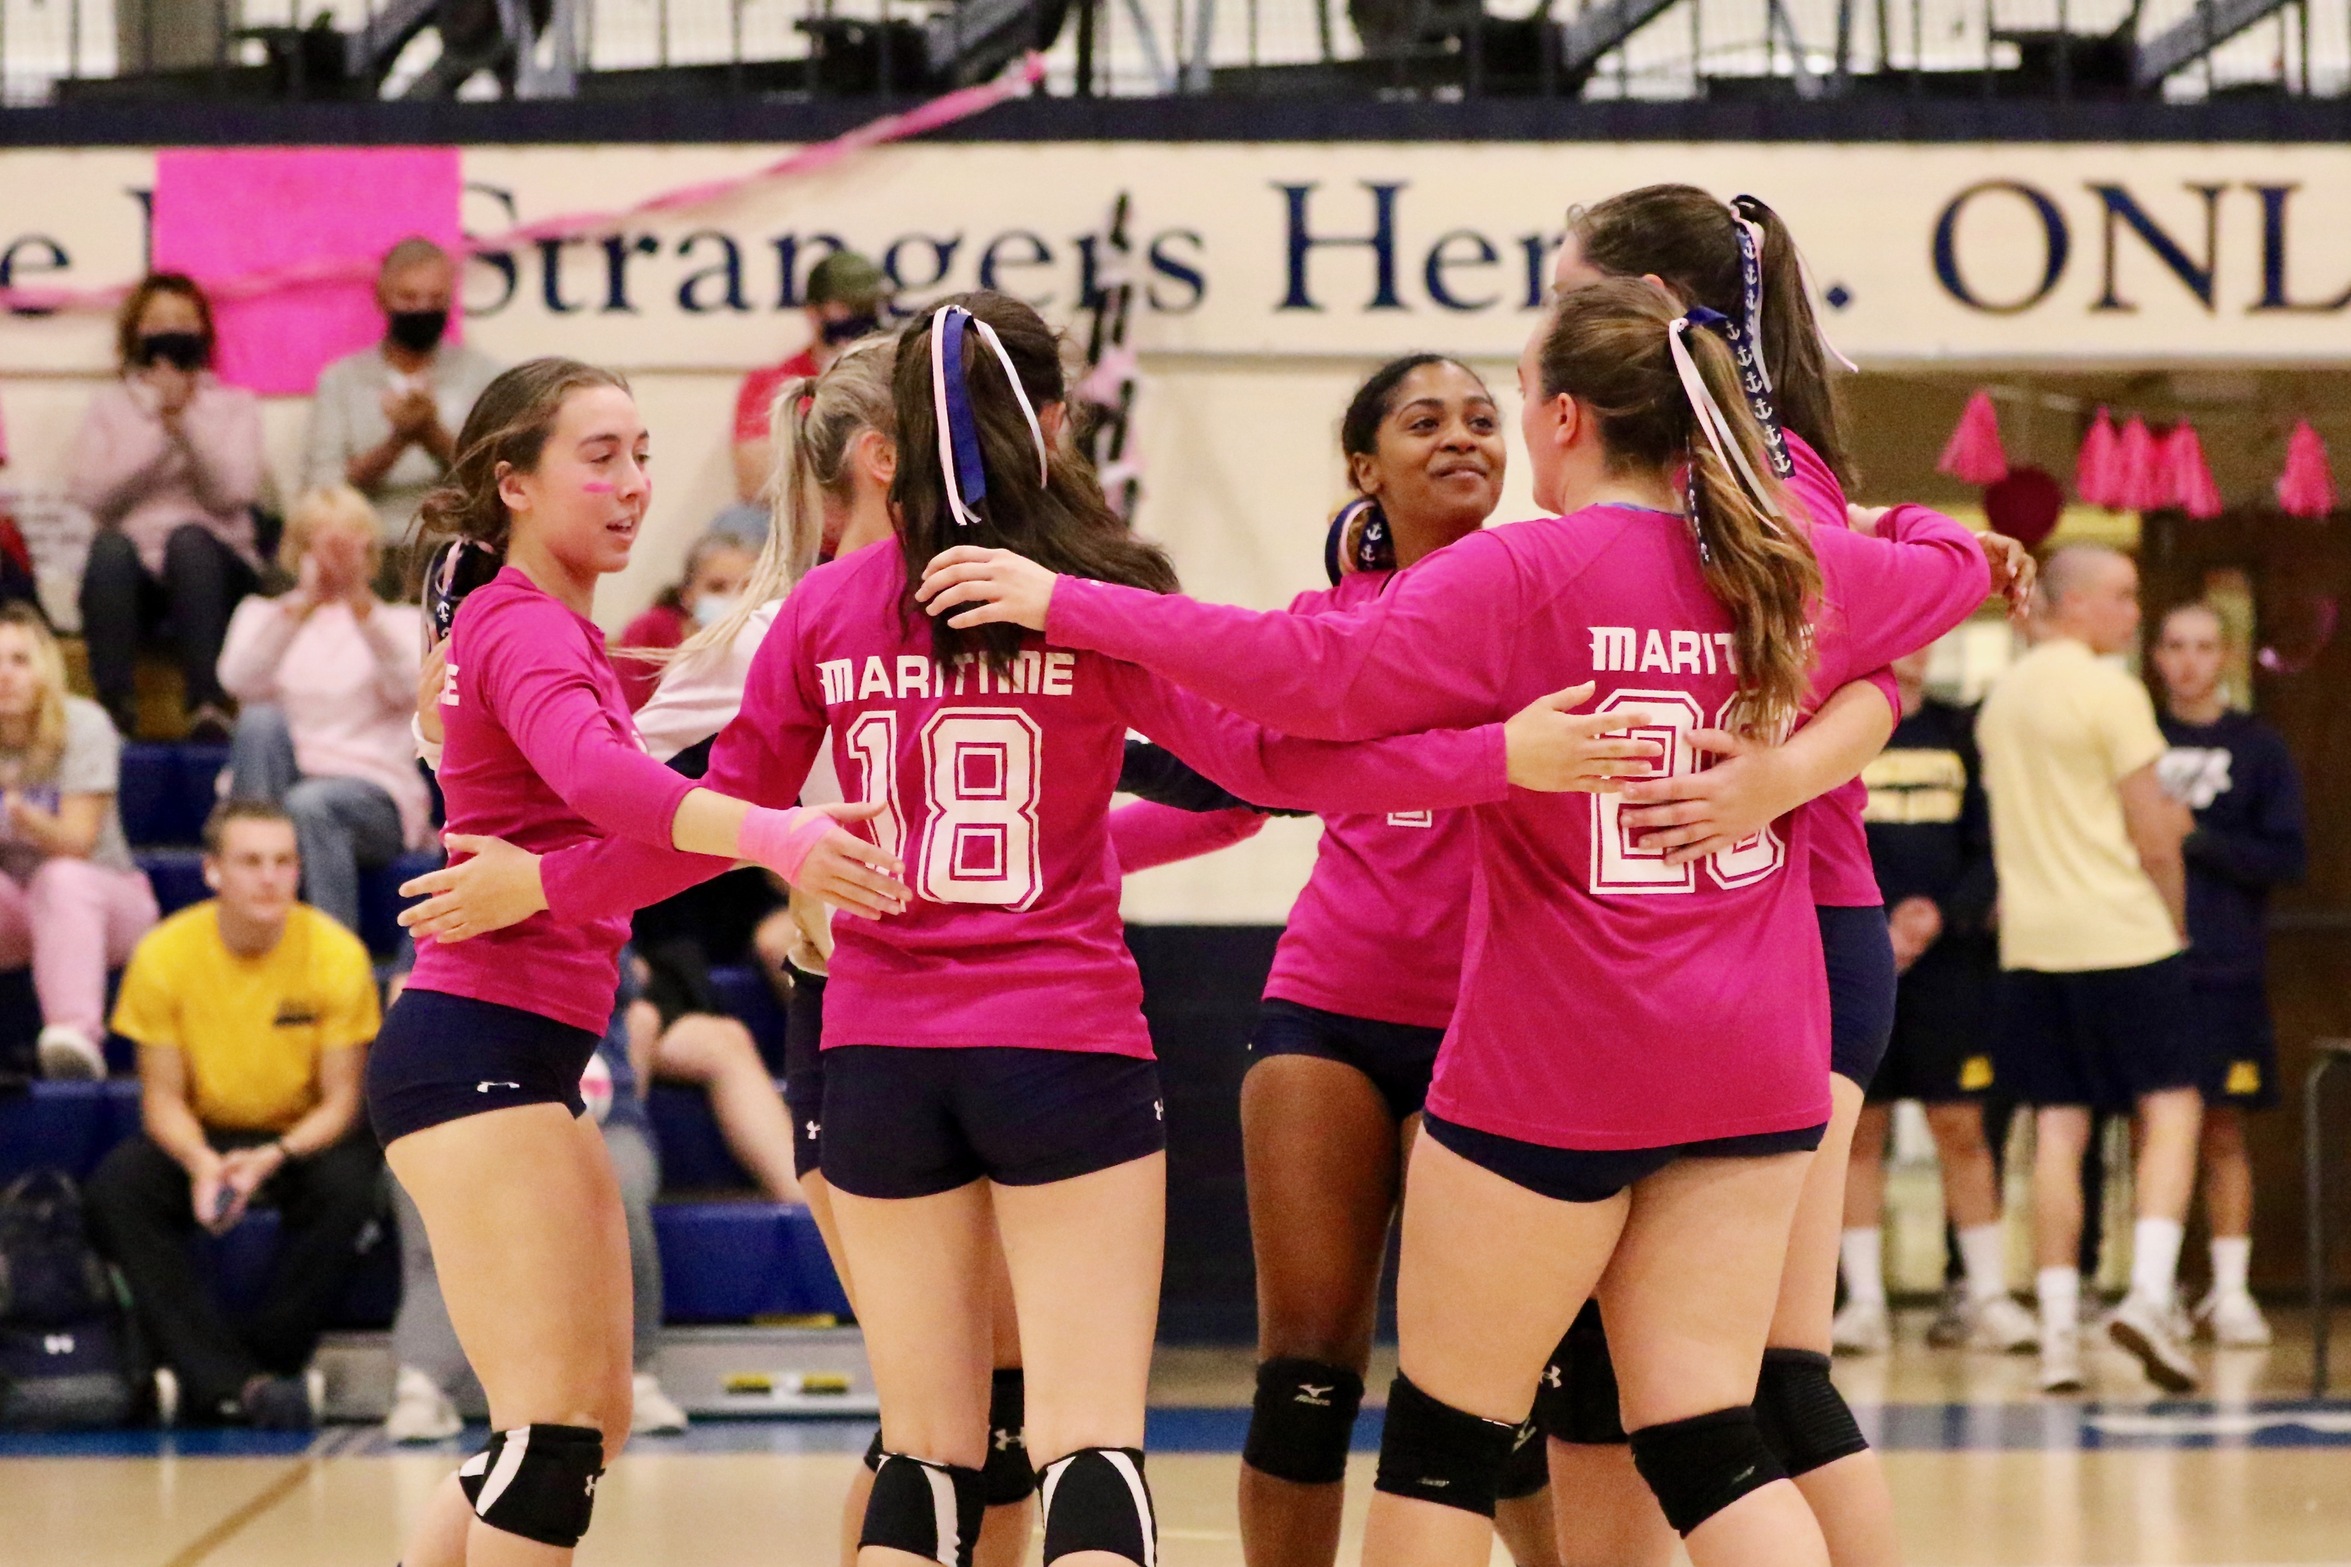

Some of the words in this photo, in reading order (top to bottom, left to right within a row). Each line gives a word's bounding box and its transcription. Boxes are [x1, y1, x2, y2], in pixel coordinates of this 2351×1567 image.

[1273, 181, 1572, 310] Her
[1930, 178, 2351, 315] ONL
[815, 650, 1076, 706] MARITIME
[1587, 623, 1815, 675] MARIT
[846, 706, 1044, 913] 18
